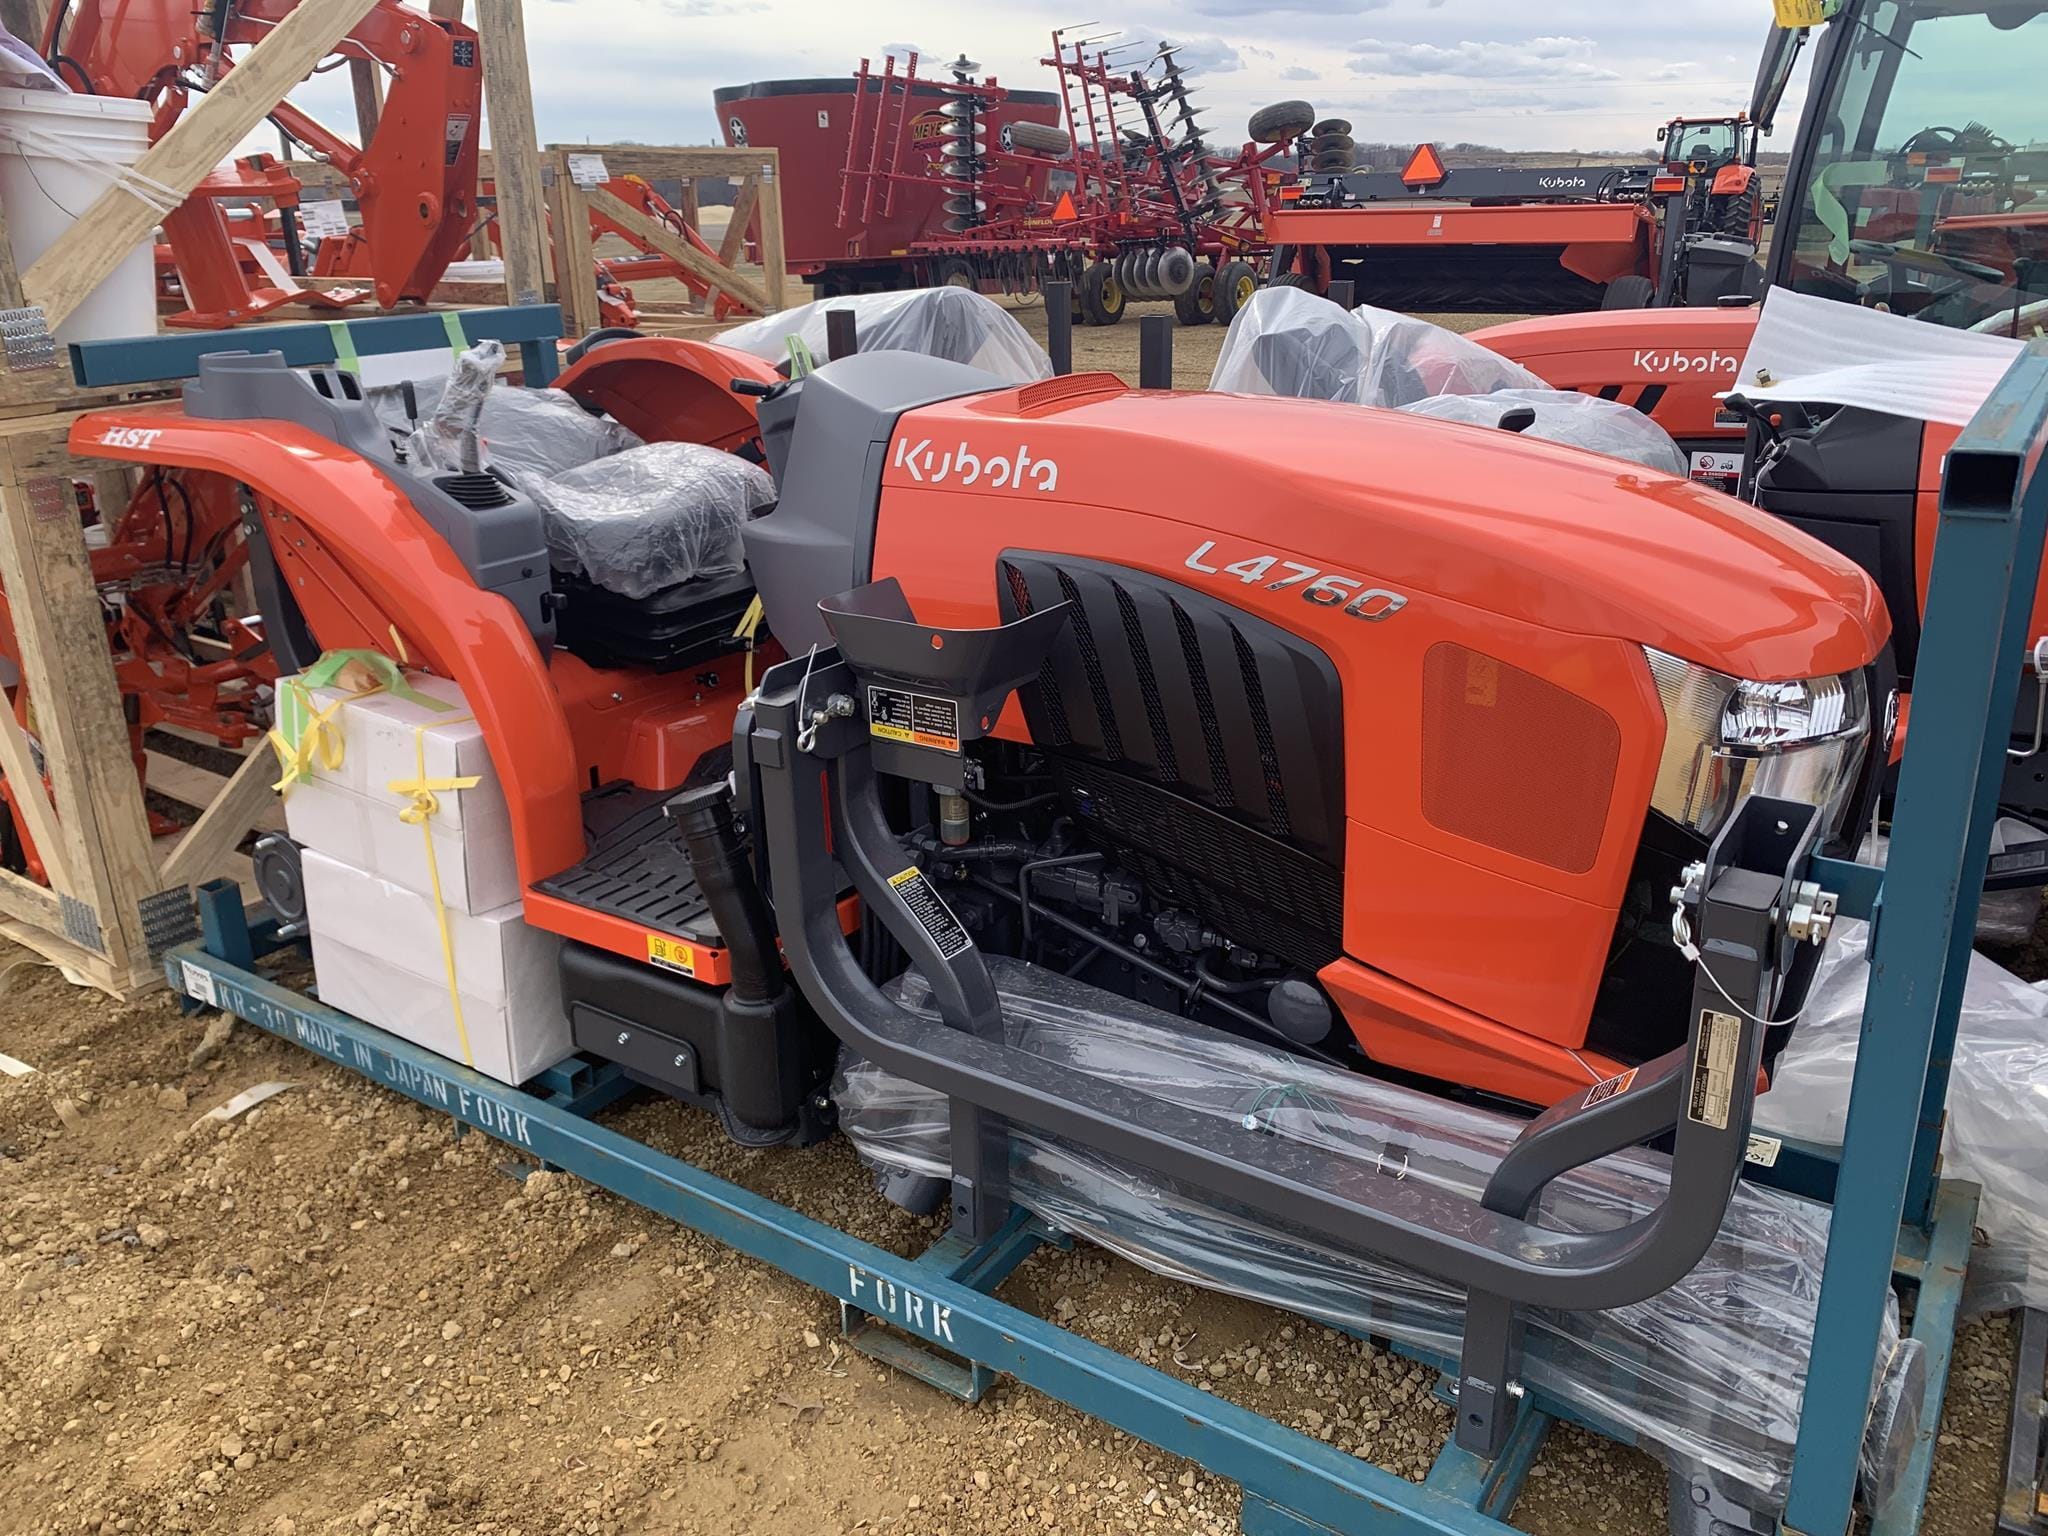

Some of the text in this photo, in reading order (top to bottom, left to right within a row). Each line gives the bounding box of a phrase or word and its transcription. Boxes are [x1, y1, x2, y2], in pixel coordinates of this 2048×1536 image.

[1539, 176, 1586, 188] Kubota
[1633, 350, 1738, 373] Kubota
[100, 425, 162, 450] HST
[893, 437, 1060, 492] Kubota
[1184, 540, 1409, 622] L4760
[877, 726, 902, 737] CAUTION
[918, 734, 947, 746] WARNING
[294, 1016, 345, 1060] MADE
[352, 1046, 373, 1073] IN
[384, 1060, 449, 1106] JAPAN
[457, 1088, 533, 1146] FORK
[849, 1263, 954, 1343] FORK
